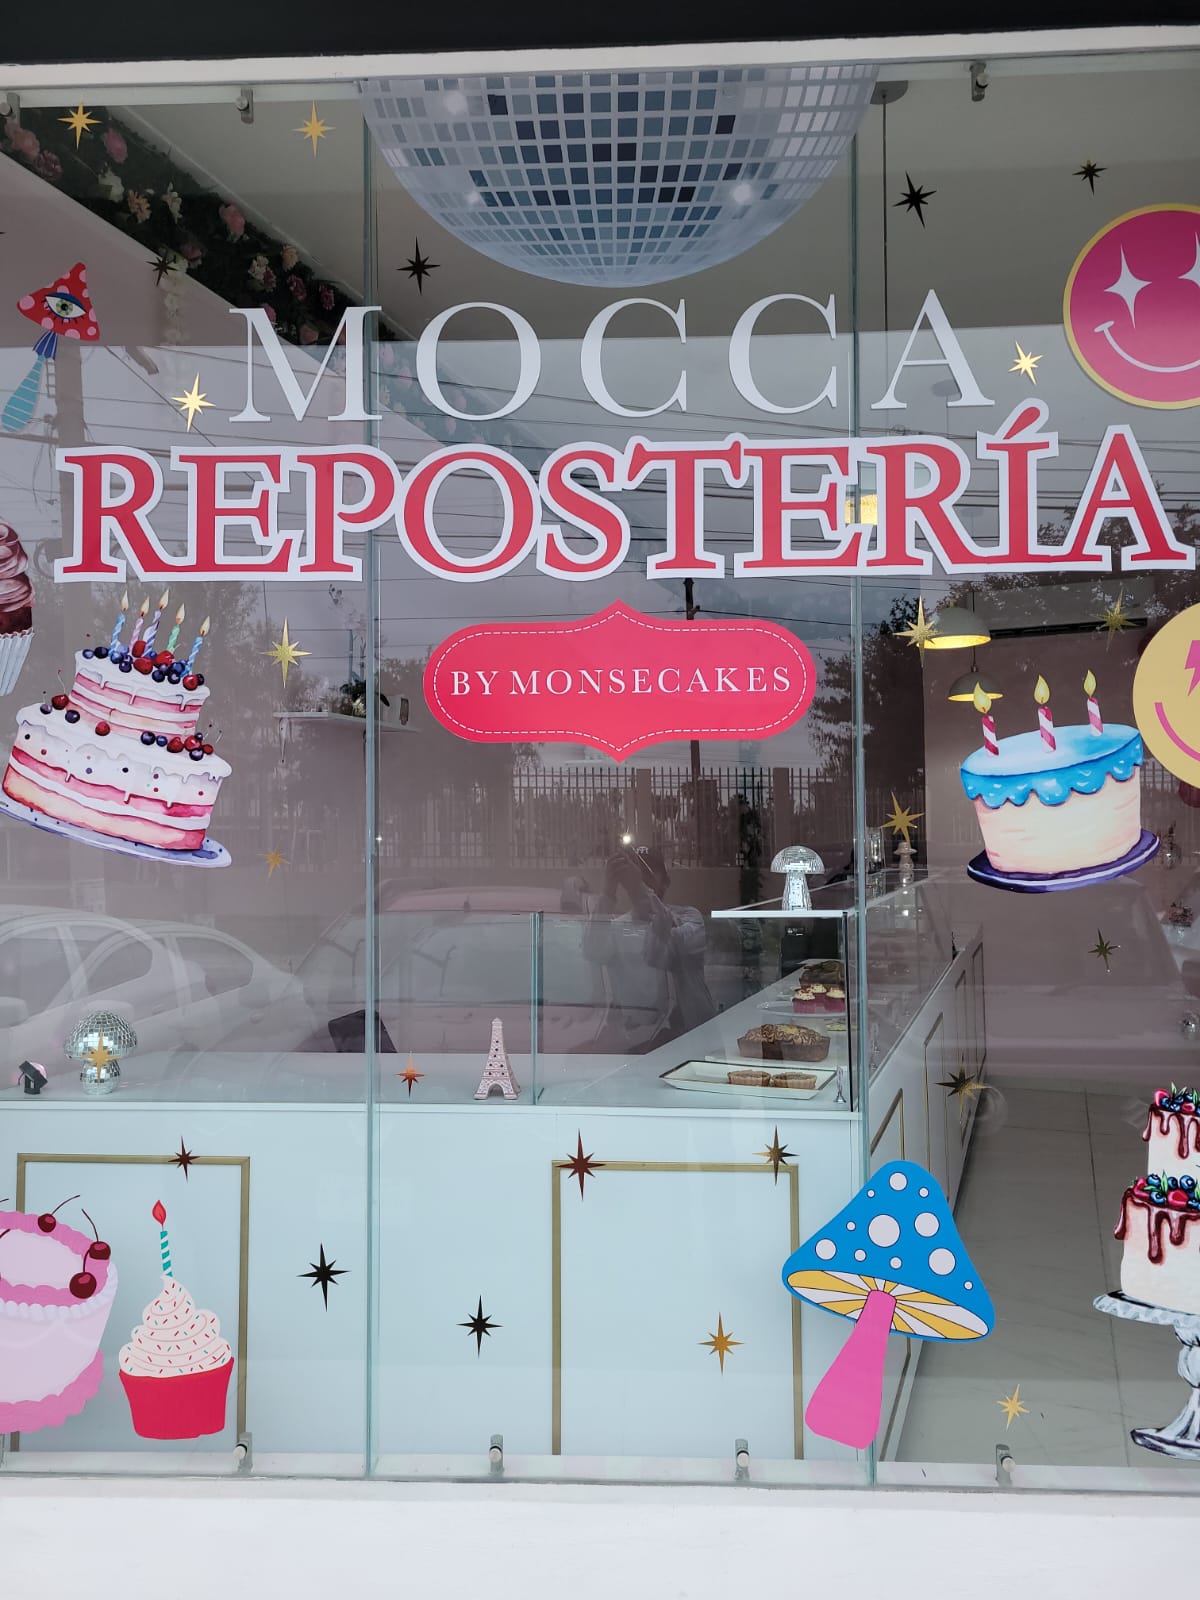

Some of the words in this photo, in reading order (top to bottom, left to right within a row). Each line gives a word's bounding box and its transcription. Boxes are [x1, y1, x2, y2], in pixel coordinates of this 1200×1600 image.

[228, 289, 995, 423] MOCCA
[54, 398, 1197, 583] REPOSTERÍA
[450, 671, 498, 696] BY
[509, 667, 792, 696] MONSECAKES
